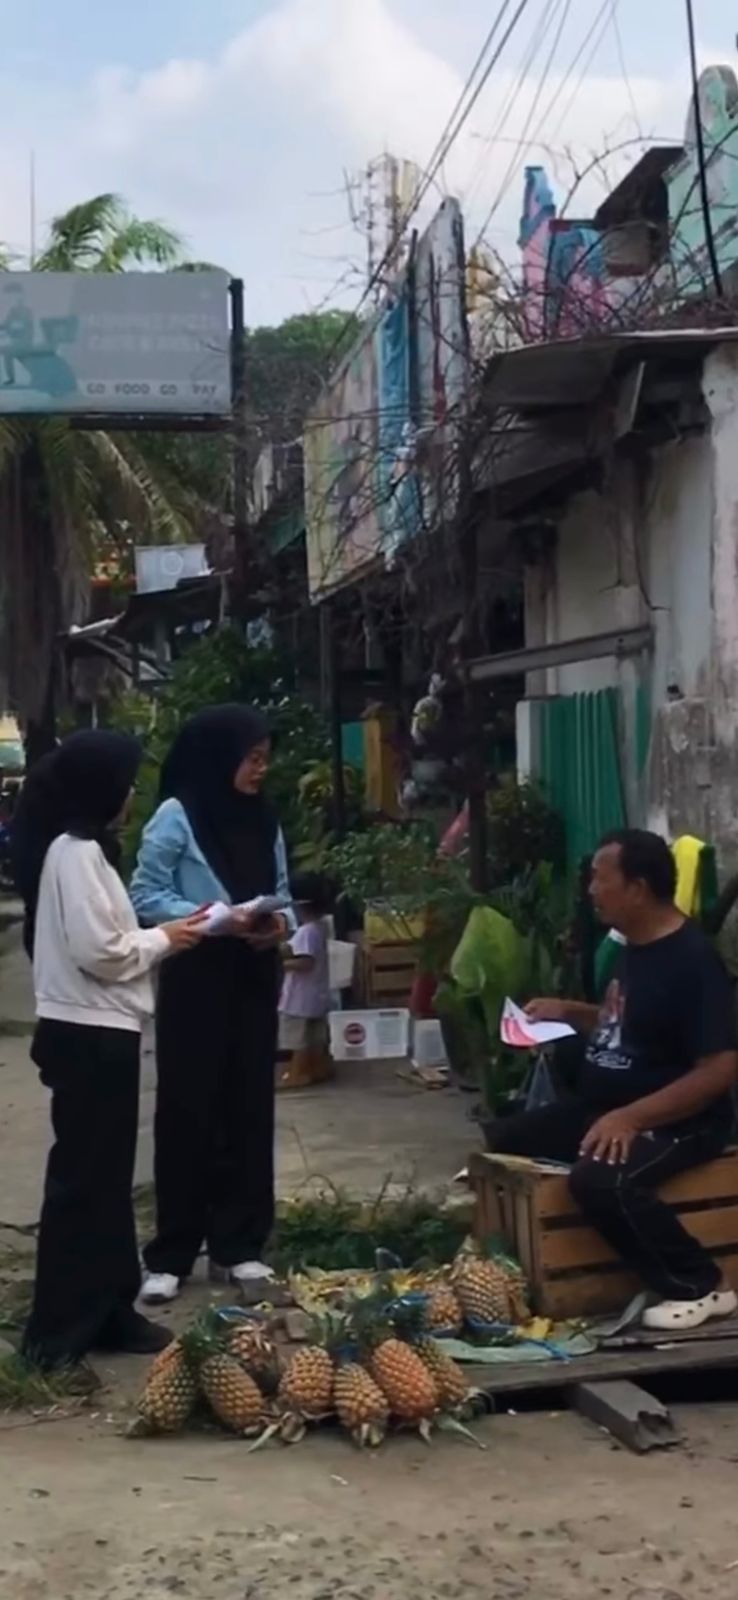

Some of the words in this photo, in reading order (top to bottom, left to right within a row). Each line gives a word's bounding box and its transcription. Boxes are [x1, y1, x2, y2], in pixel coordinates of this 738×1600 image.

[86, 383, 106, 395] GO
[115, 383, 150, 395] FOOD
[160, 384, 178, 396] GO
[192, 384, 217, 395] PAY
